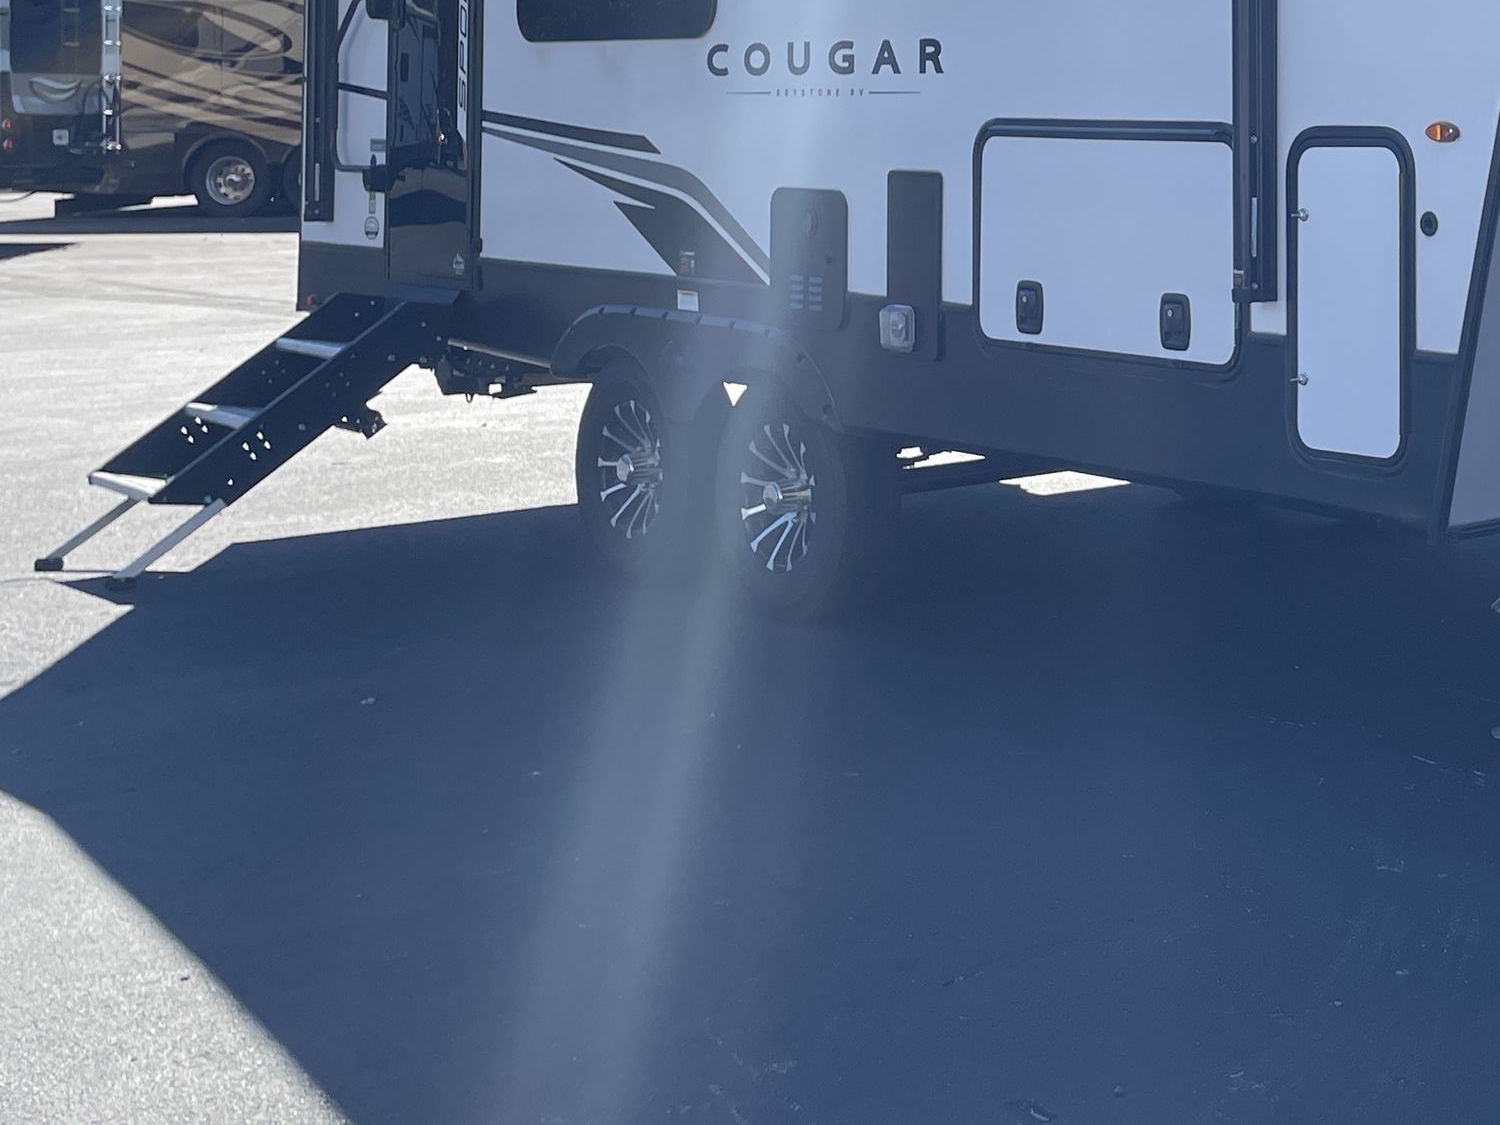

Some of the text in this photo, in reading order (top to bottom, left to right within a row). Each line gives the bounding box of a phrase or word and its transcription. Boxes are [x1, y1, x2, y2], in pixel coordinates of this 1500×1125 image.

[706, 38, 945, 76] COUGAR
[776, 87, 864, 97] KEYSTONE RV
